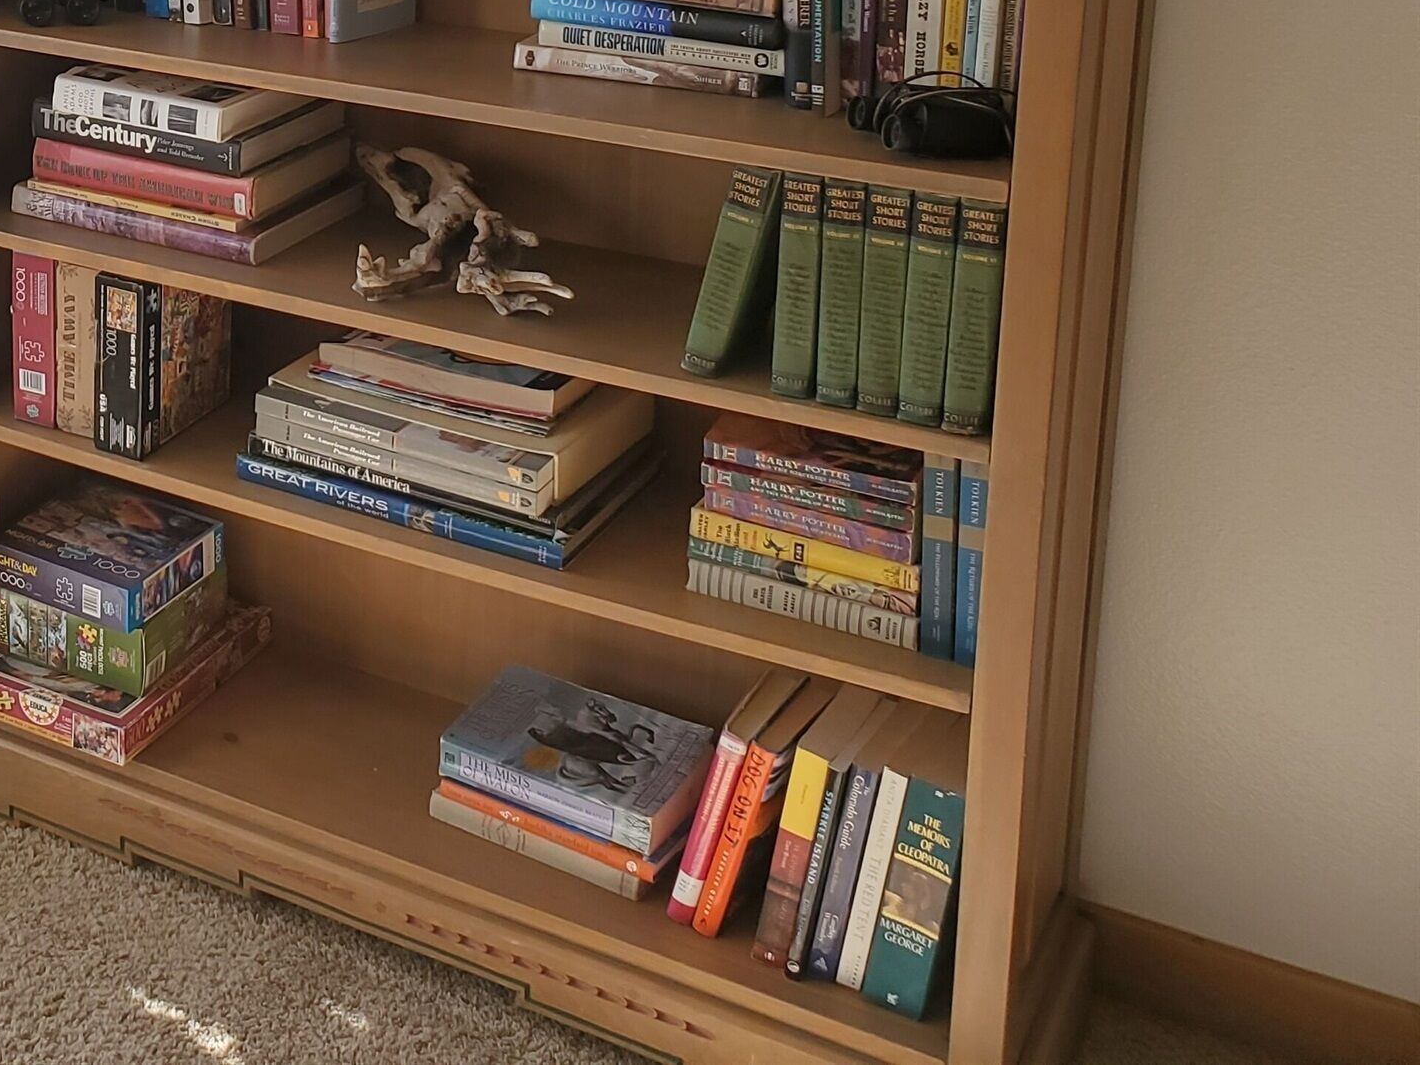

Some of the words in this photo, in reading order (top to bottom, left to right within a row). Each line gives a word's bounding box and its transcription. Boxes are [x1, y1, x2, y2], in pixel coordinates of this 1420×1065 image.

[546, 8, 606, 26] CHARLES
[610, 17, 666, 34] FRAZIER
[602, 0, 700, 26] MOUNTAIN
[562, 26, 591, 46] QUIET
[594, 30, 666, 57] DESPERATION
[915, 31, 927, 76] HORSE
[571, 60, 597, 71] PRINCE
[69, 84, 77, 112] ADAMS
[156, 146, 168, 154] and
[168, 147, 181, 156] Todd
[732, 170, 768, 188] GREATEST
[734, 182, 761, 196] SHORT
[784, 179, 820, 193] GREATEST
[728, 191, 761, 208] STORIES
[786, 191, 815, 203] SHORT
[825, 188, 865, 200] GREATEST
[830, 198, 859, 210] SHORT
[871, 194, 911, 209] GREATEST
[783, 203, 817, 214] STORIES
[827, 210, 862, 221] STORIES
[875, 206, 905, 217] SHORT
[916, 201, 956, 216] GREATEST
[921, 212, 950, 225] SHORT
[962, 209, 1003, 222] GREATEST
[871, 215, 907, 229] STORIES
[917, 224, 953, 237] STORIES
[967, 220, 998, 233] SHORT
[963, 231, 1000, 244] STORIES
[15, 267, 26, 302] 1000
[63, 293, 76, 347] AWAY
[106, 327, 117, 356] 1000
[130, 356, 137, 366] We
[63, 351, 76, 402] TIME
[129, 367, 137, 389] Played
[99, 393, 107, 412] USA
[303, 410, 316, 418] The
[317, 414, 349, 428] American
[349, 422, 381, 437] Railroad
[332, 425, 366, 442] Passenger
[367, 435, 380, 443] Car
[303, 433, 316, 441] The
[317, 436, 349, 452] American
[349, 445, 381, 461] Railroad
[332, 448, 366, 465] Passenger
[367, 458, 380, 466] Car
[262, 439, 285, 457] The
[285, 446, 347, 475] Mountains
[347, 462, 361, 479] of
[360, 468, 411, 494] America
[754, 453, 801, 470] HARRY
[804, 464, 852, 482] POTTER
[755, 462, 772, 471] AND
[248, 463, 312, 489] GREAT
[315, 479, 389, 512] RIVERS
[750, 477, 796, 495] HARRY
[799, 489, 847, 507] POTTER
[935, 471, 944, 514] TOLKIEN
[336, 499, 346, 508] of
[347, 502, 362, 511] the
[364, 507, 389, 519] world
[970, 481, 980, 525] TOLKIEN
[753, 502, 798, 522] HARRY
[801, 514, 847, 535] POTTER
[92, 558, 141, 580] 1000
[80, 650, 88, 670] 500
[29, 700, 48, 714] EDUCA
[467, 756, 490, 771] THE
[495, 767, 530, 788] MISTS
[744, 750, 765, 791] DOG
[462, 766, 478, 779] OF
[478, 772, 531, 800] AVALON
[733, 794, 752, 820] ON
[846, 775, 865, 822] Colorado
[815, 790, 834, 841] SPARKLE
[924, 813, 943, 832] THE
[723, 822, 744, 849] IT
[839, 821, 856, 851] Guide
[907, 821, 952, 850] MEMOIRS
[920, 839, 934, 853] OF
[806, 841, 822, 885] ISLAND
[869, 856, 882, 879] THE
[897, 842, 950, 876] CLEOPATRA
[864, 881, 877, 910] RED
[856, 910, 870, 944] TENT
[880, 917, 934, 950] MARGARET
[884, 931, 925, 957] GEORGE
